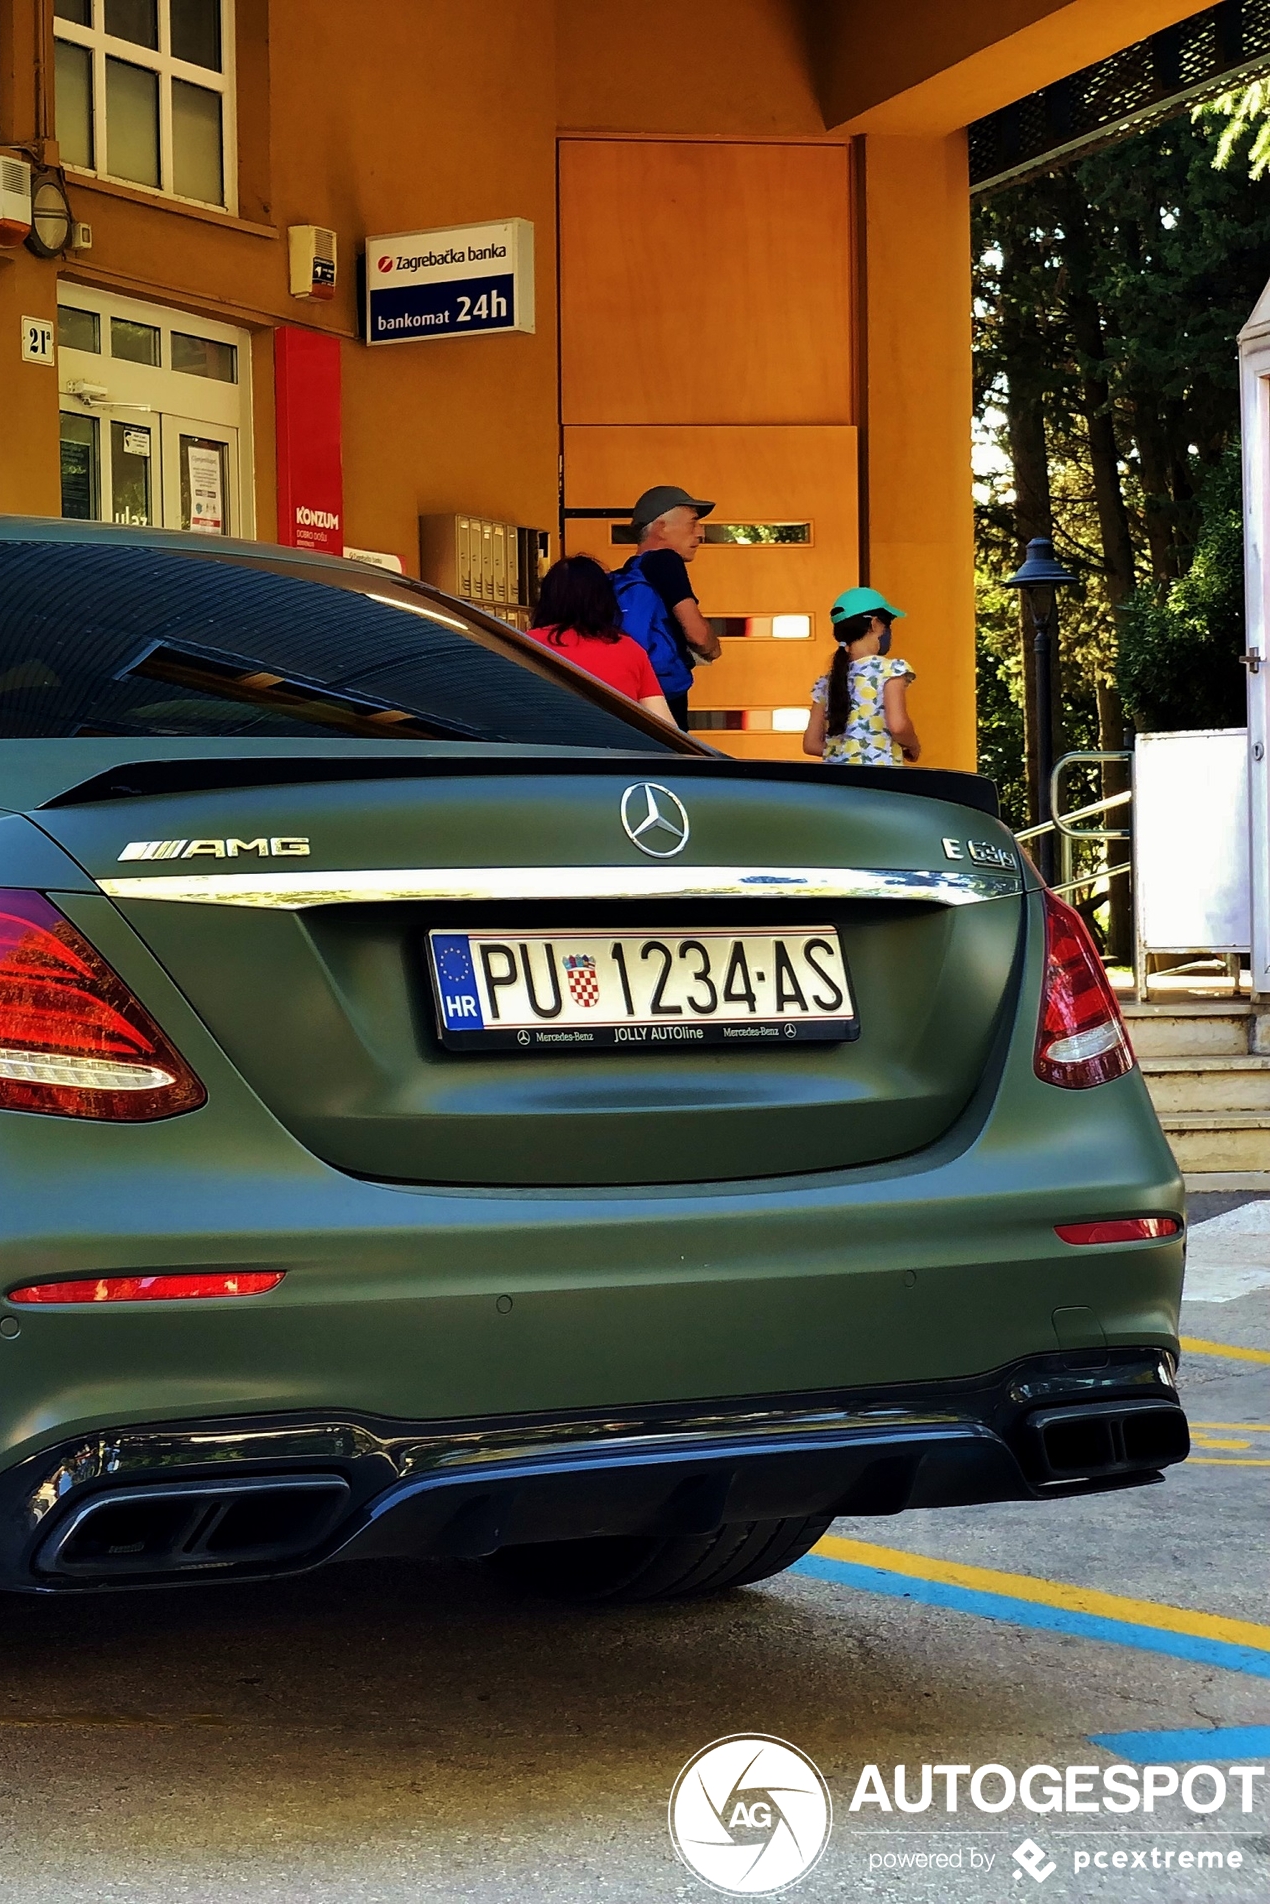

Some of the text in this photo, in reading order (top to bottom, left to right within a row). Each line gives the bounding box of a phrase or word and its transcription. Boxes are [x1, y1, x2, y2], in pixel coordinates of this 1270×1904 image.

[396, 243, 507, 273] Zagrebačka banka
[378, 290, 507, 331] bankomat 24h
[296, 505, 339, 531] KONZUM
[296, 529, 314, 540] DOBRO
[180, 837, 311, 859] AMG
[942, 838, 964, 860] E
[479, 942, 563, 1019] PU
[445, 995, 478, 1018] HR
[536, 1031, 594, 1043] Mercedes-Benz
[614, 1026, 704, 1043] JOLLY AUTOline
[723, 1026, 779, 1038] Mercedes-Benz
